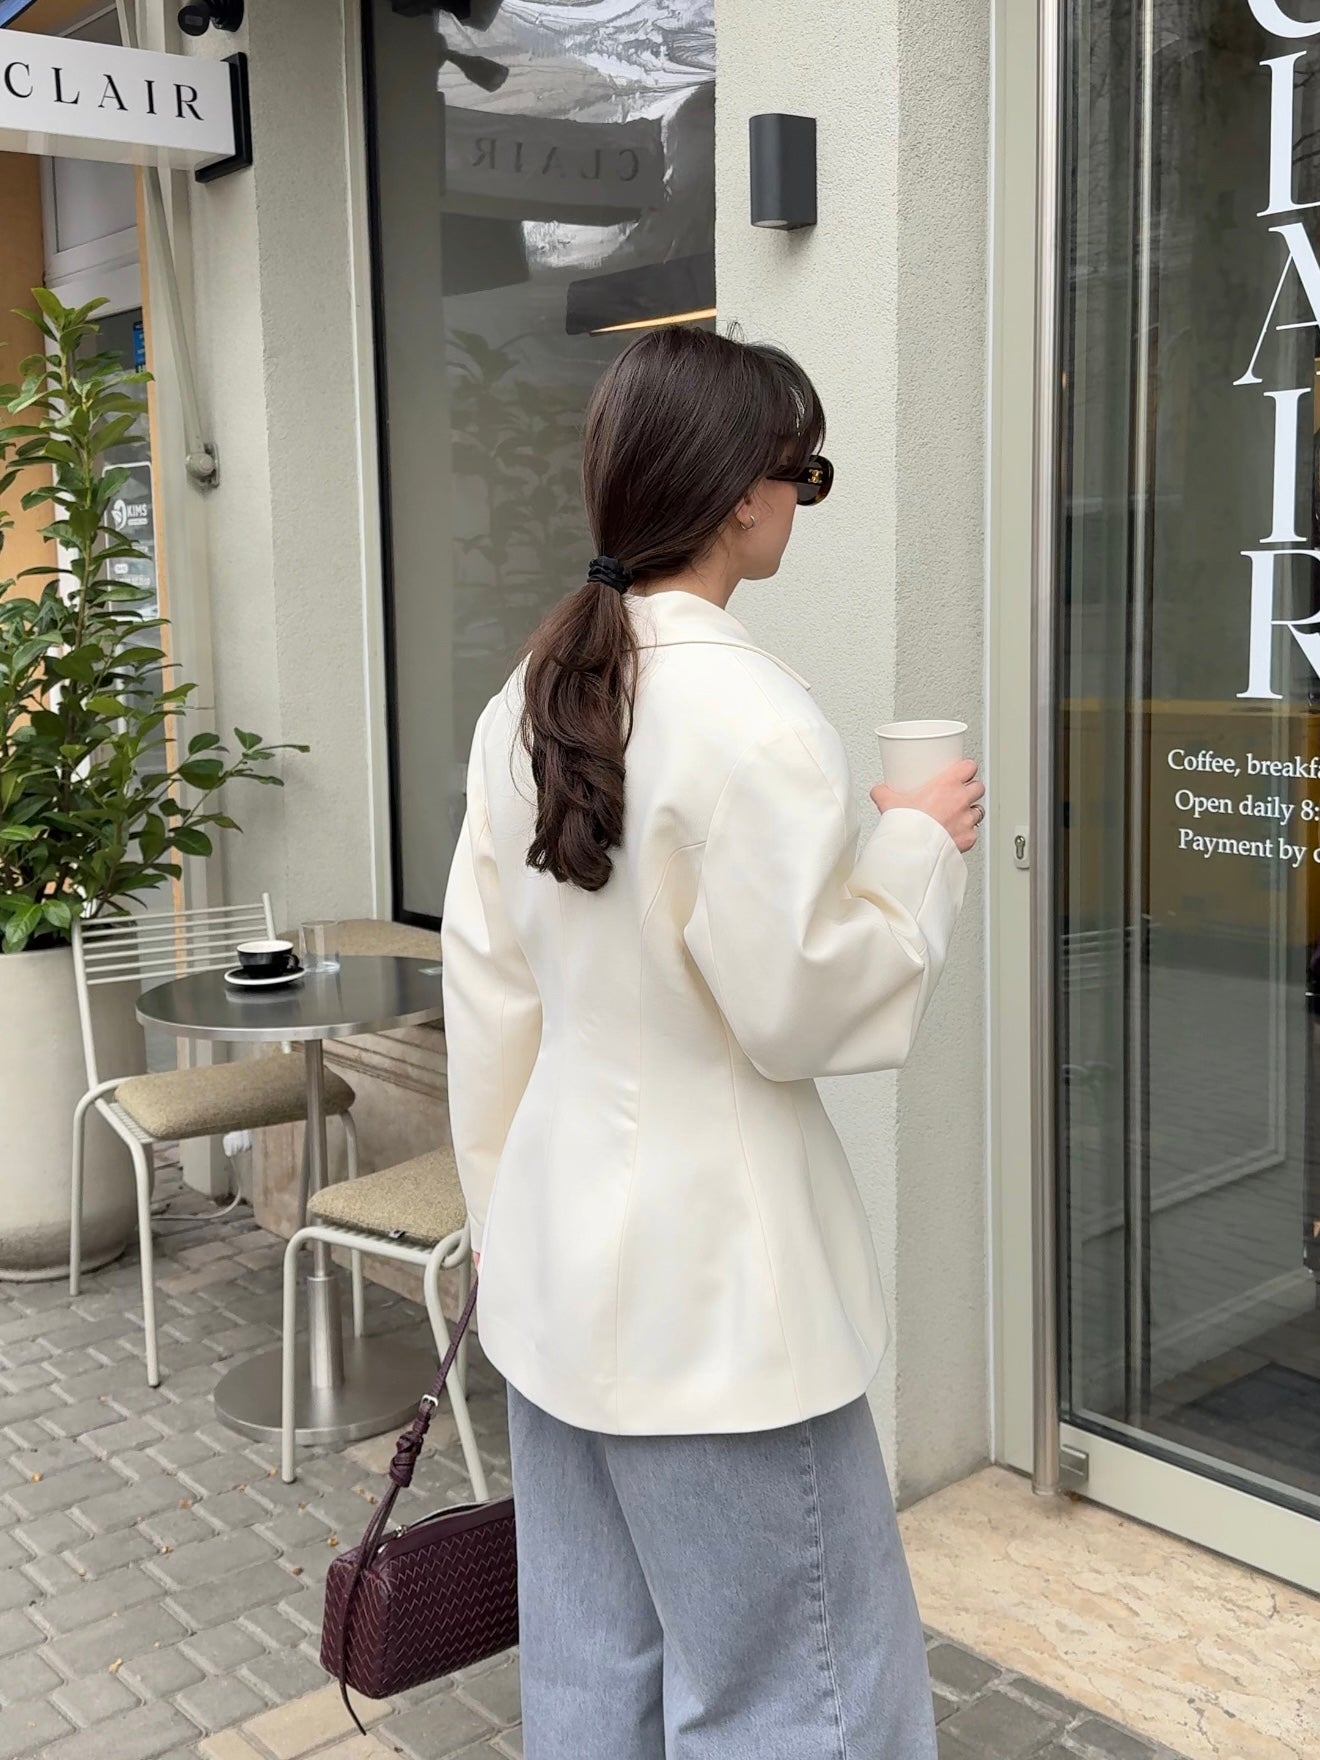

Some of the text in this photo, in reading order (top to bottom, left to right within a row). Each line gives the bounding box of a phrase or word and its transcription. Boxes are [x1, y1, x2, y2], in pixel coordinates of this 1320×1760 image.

[4, 61, 204, 121] CLAIR
[1232, 0, 1320, 699] LAIR
[1168, 749, 1241, 777] Coffee,
[1175, 789, 1234, 818] Open
[1239, 795, 1295, 825] daily
[1178, 828, 1273, 858] Payment
[1278, 838, 1307, 868] by
